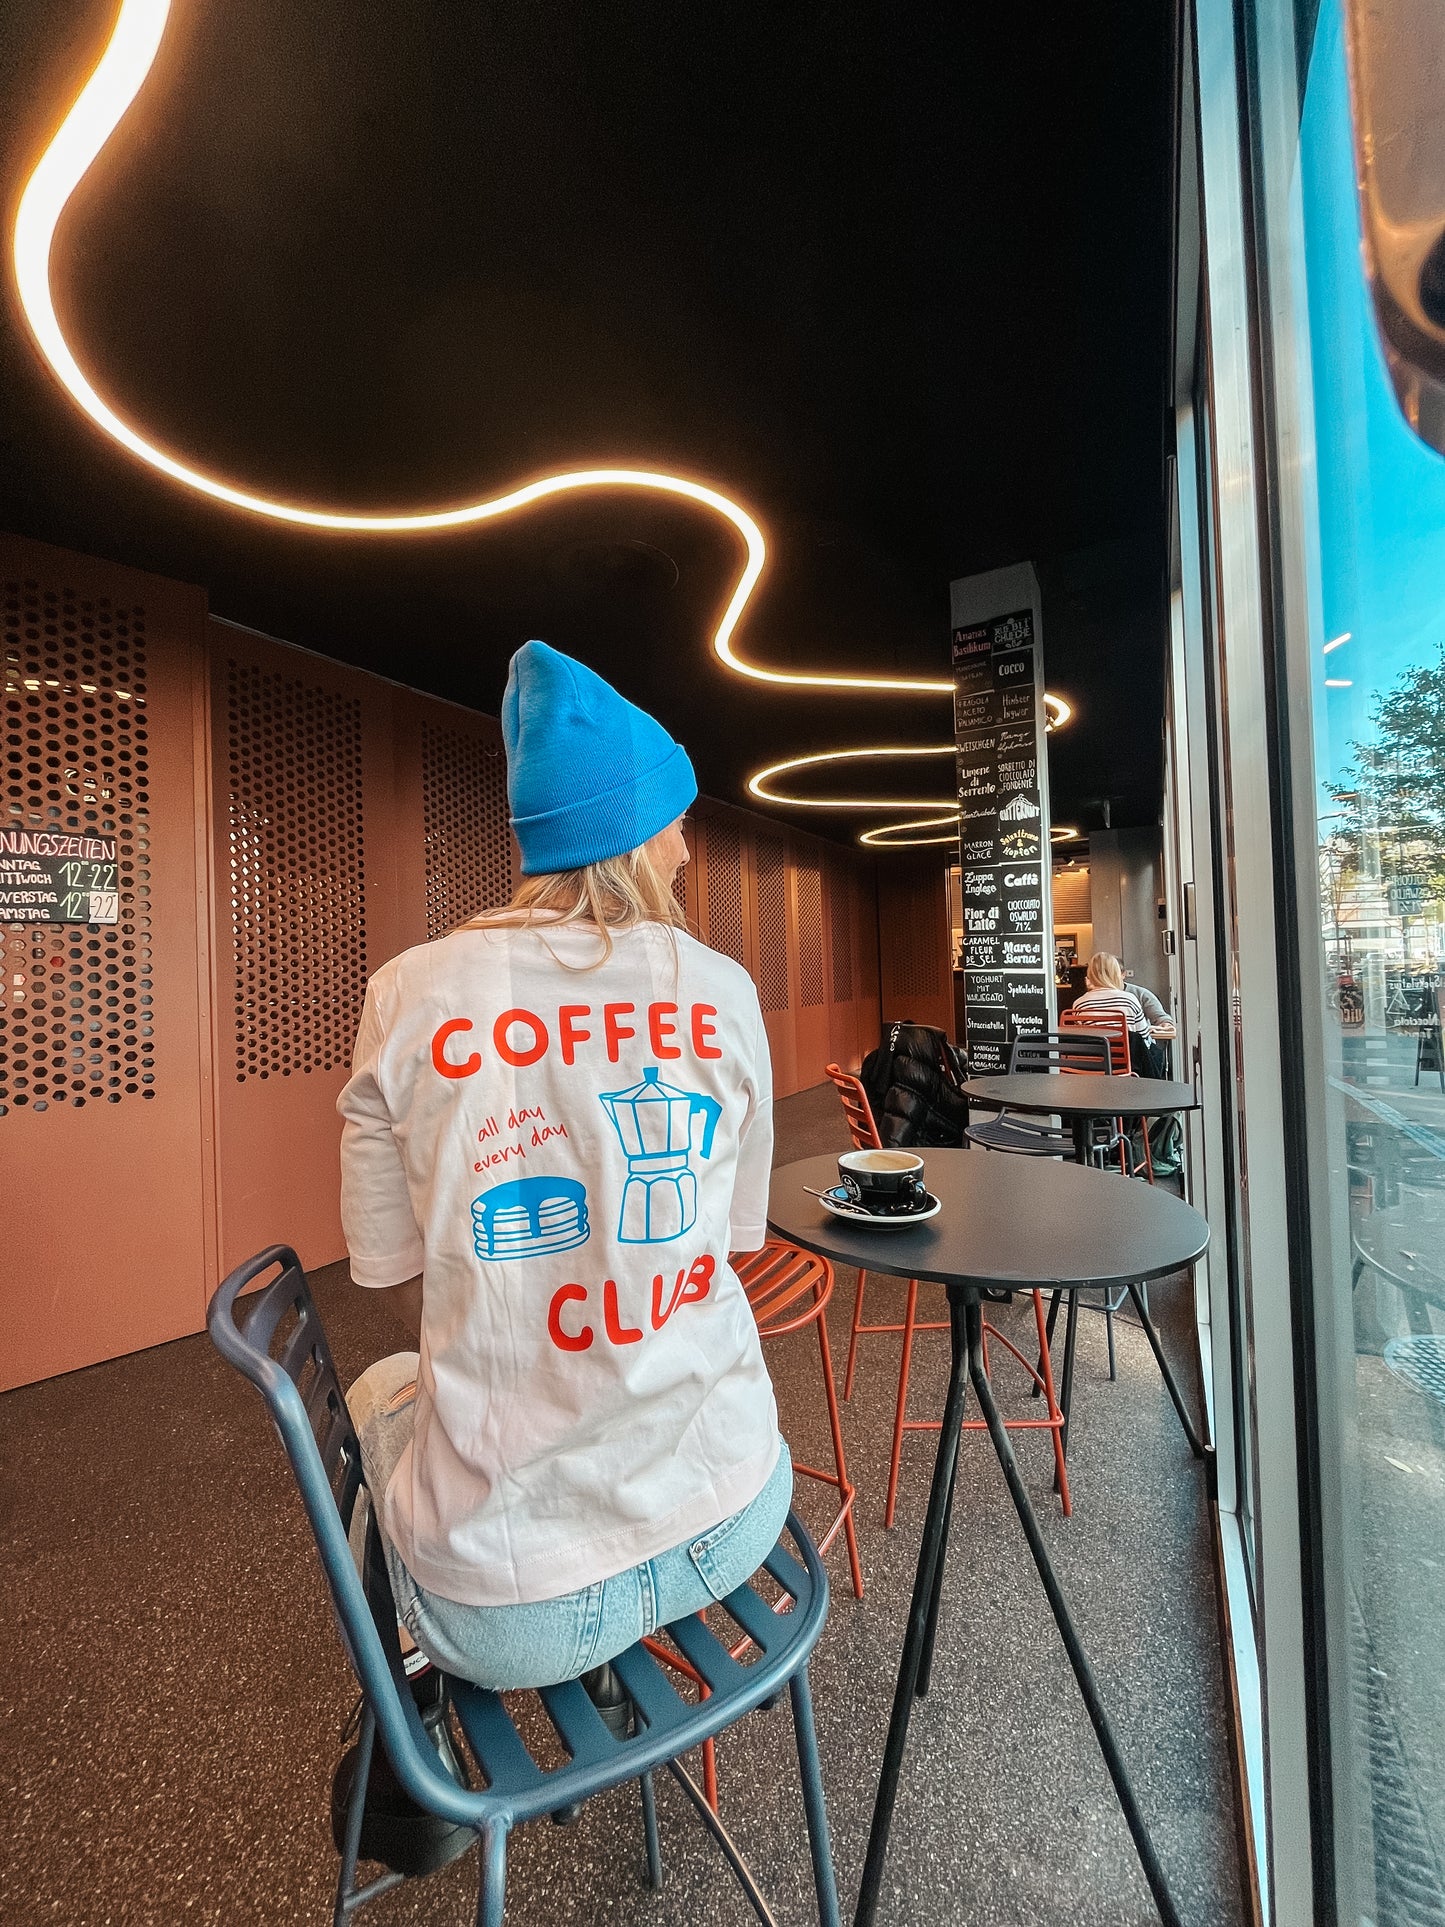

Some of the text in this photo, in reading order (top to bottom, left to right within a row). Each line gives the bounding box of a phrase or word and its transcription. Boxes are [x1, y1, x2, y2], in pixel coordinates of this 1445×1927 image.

[955, 629, 987, 642] Ananas
[999, 662, 1025, 676] COCCO
[1028, 758, 1035, 768] DI
[962, 766, 990, 779] Limone
[999, 769, 1035, 782] CIOCCOLATO
[970, 777, 979, 786] di
[958, 784, 996, 798] Sorrento
[964, 840, 994, 850] MARRON
[1017, 839, 1024, 847] &
[964, 872, 994, 884] Zuppa
[965, 884, 997, 896] Inglese
[1008, 899, 1040, 910] CIOCCOLATO
[965, 907, 999, 920] Fior di
[1010, 911, 1037, 922] OSWALDO
[969, 918, 996, 930] Latte
[1015, 922, 1031, 931] 71%
[963, 937, 1000, 945] CARAMEL
[970, 946, 993, 955] FLEUR
[1002, 942, 1040, 954] Mare di
[979, 955, 996, 964] SEL
[1004, 955, 1041, 964] Berna
[971, 975, 1003, 984] YOGHURT
[1008, 983, 1044, 997] Spekulatius
[967, 1018, 1004, 1030] Stracciatella
[1012, 1014, 1042, 1025] Nocciola
[432, 1003, 722, 1078] COFFEE
[477, 1105, 545, 1142] all day
[474, 1123, 568, 1173] every day
[548, 1254, 716, 1351] CLUB
